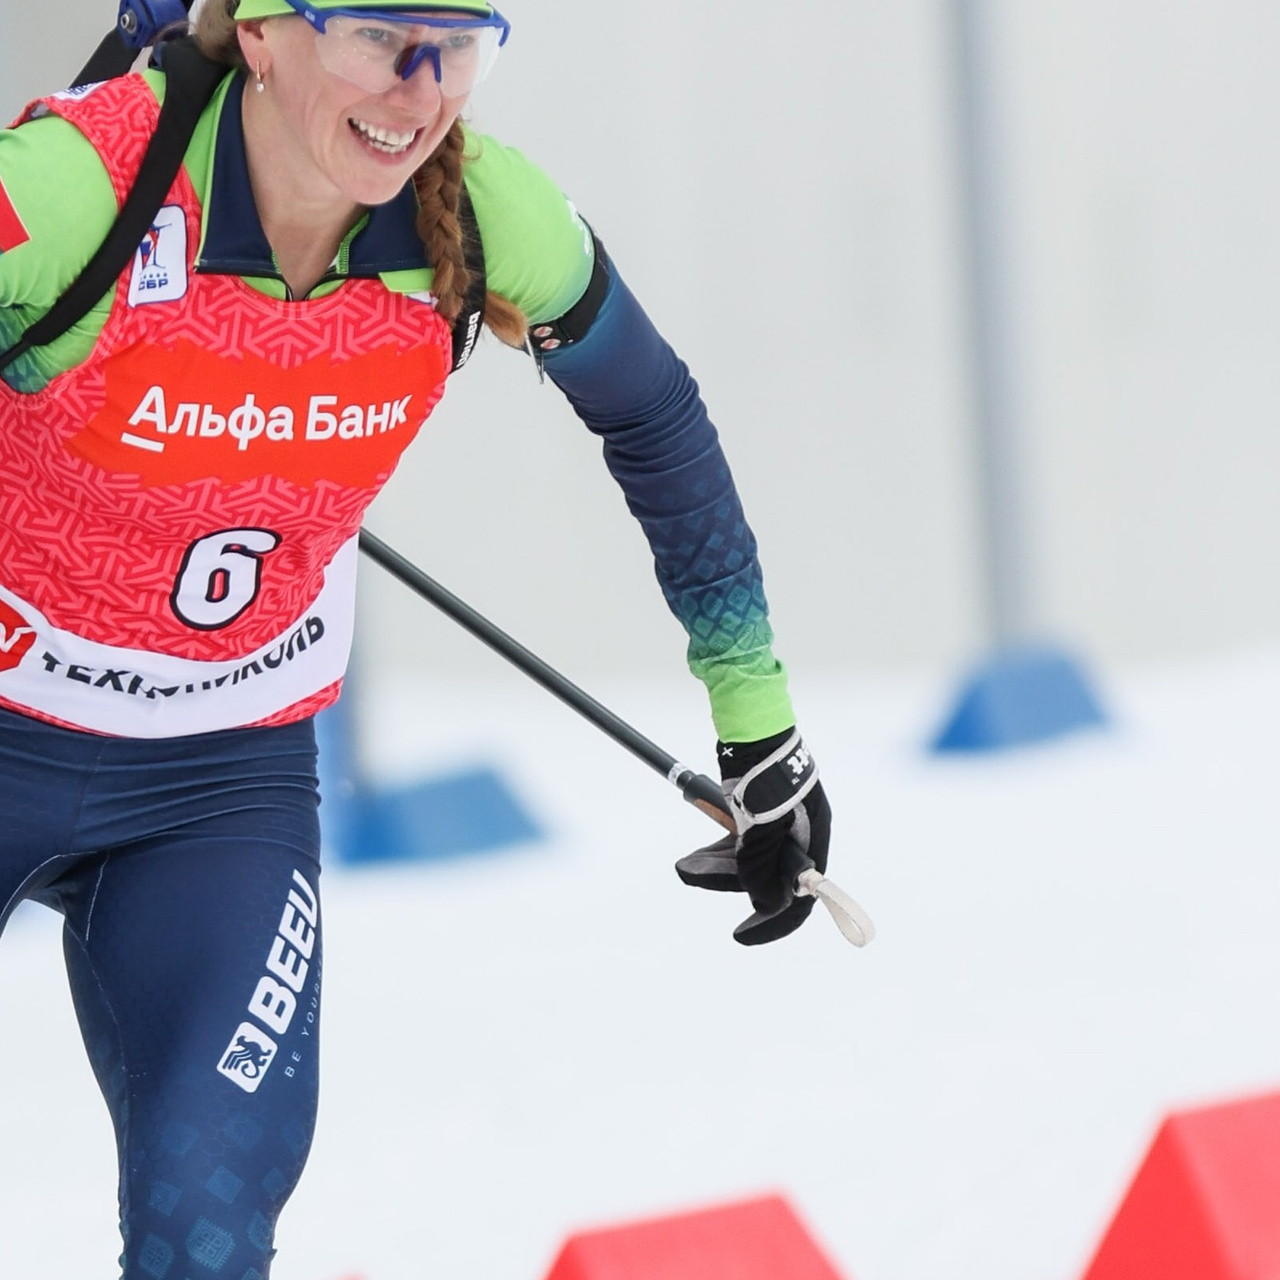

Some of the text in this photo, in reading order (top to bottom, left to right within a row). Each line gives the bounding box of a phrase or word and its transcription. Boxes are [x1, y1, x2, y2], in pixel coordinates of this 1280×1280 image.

[138, 278, 169, 291] СБР
[120, 385, 413, 453] Альфа Банк
[169, 526, 283, 632] 6
